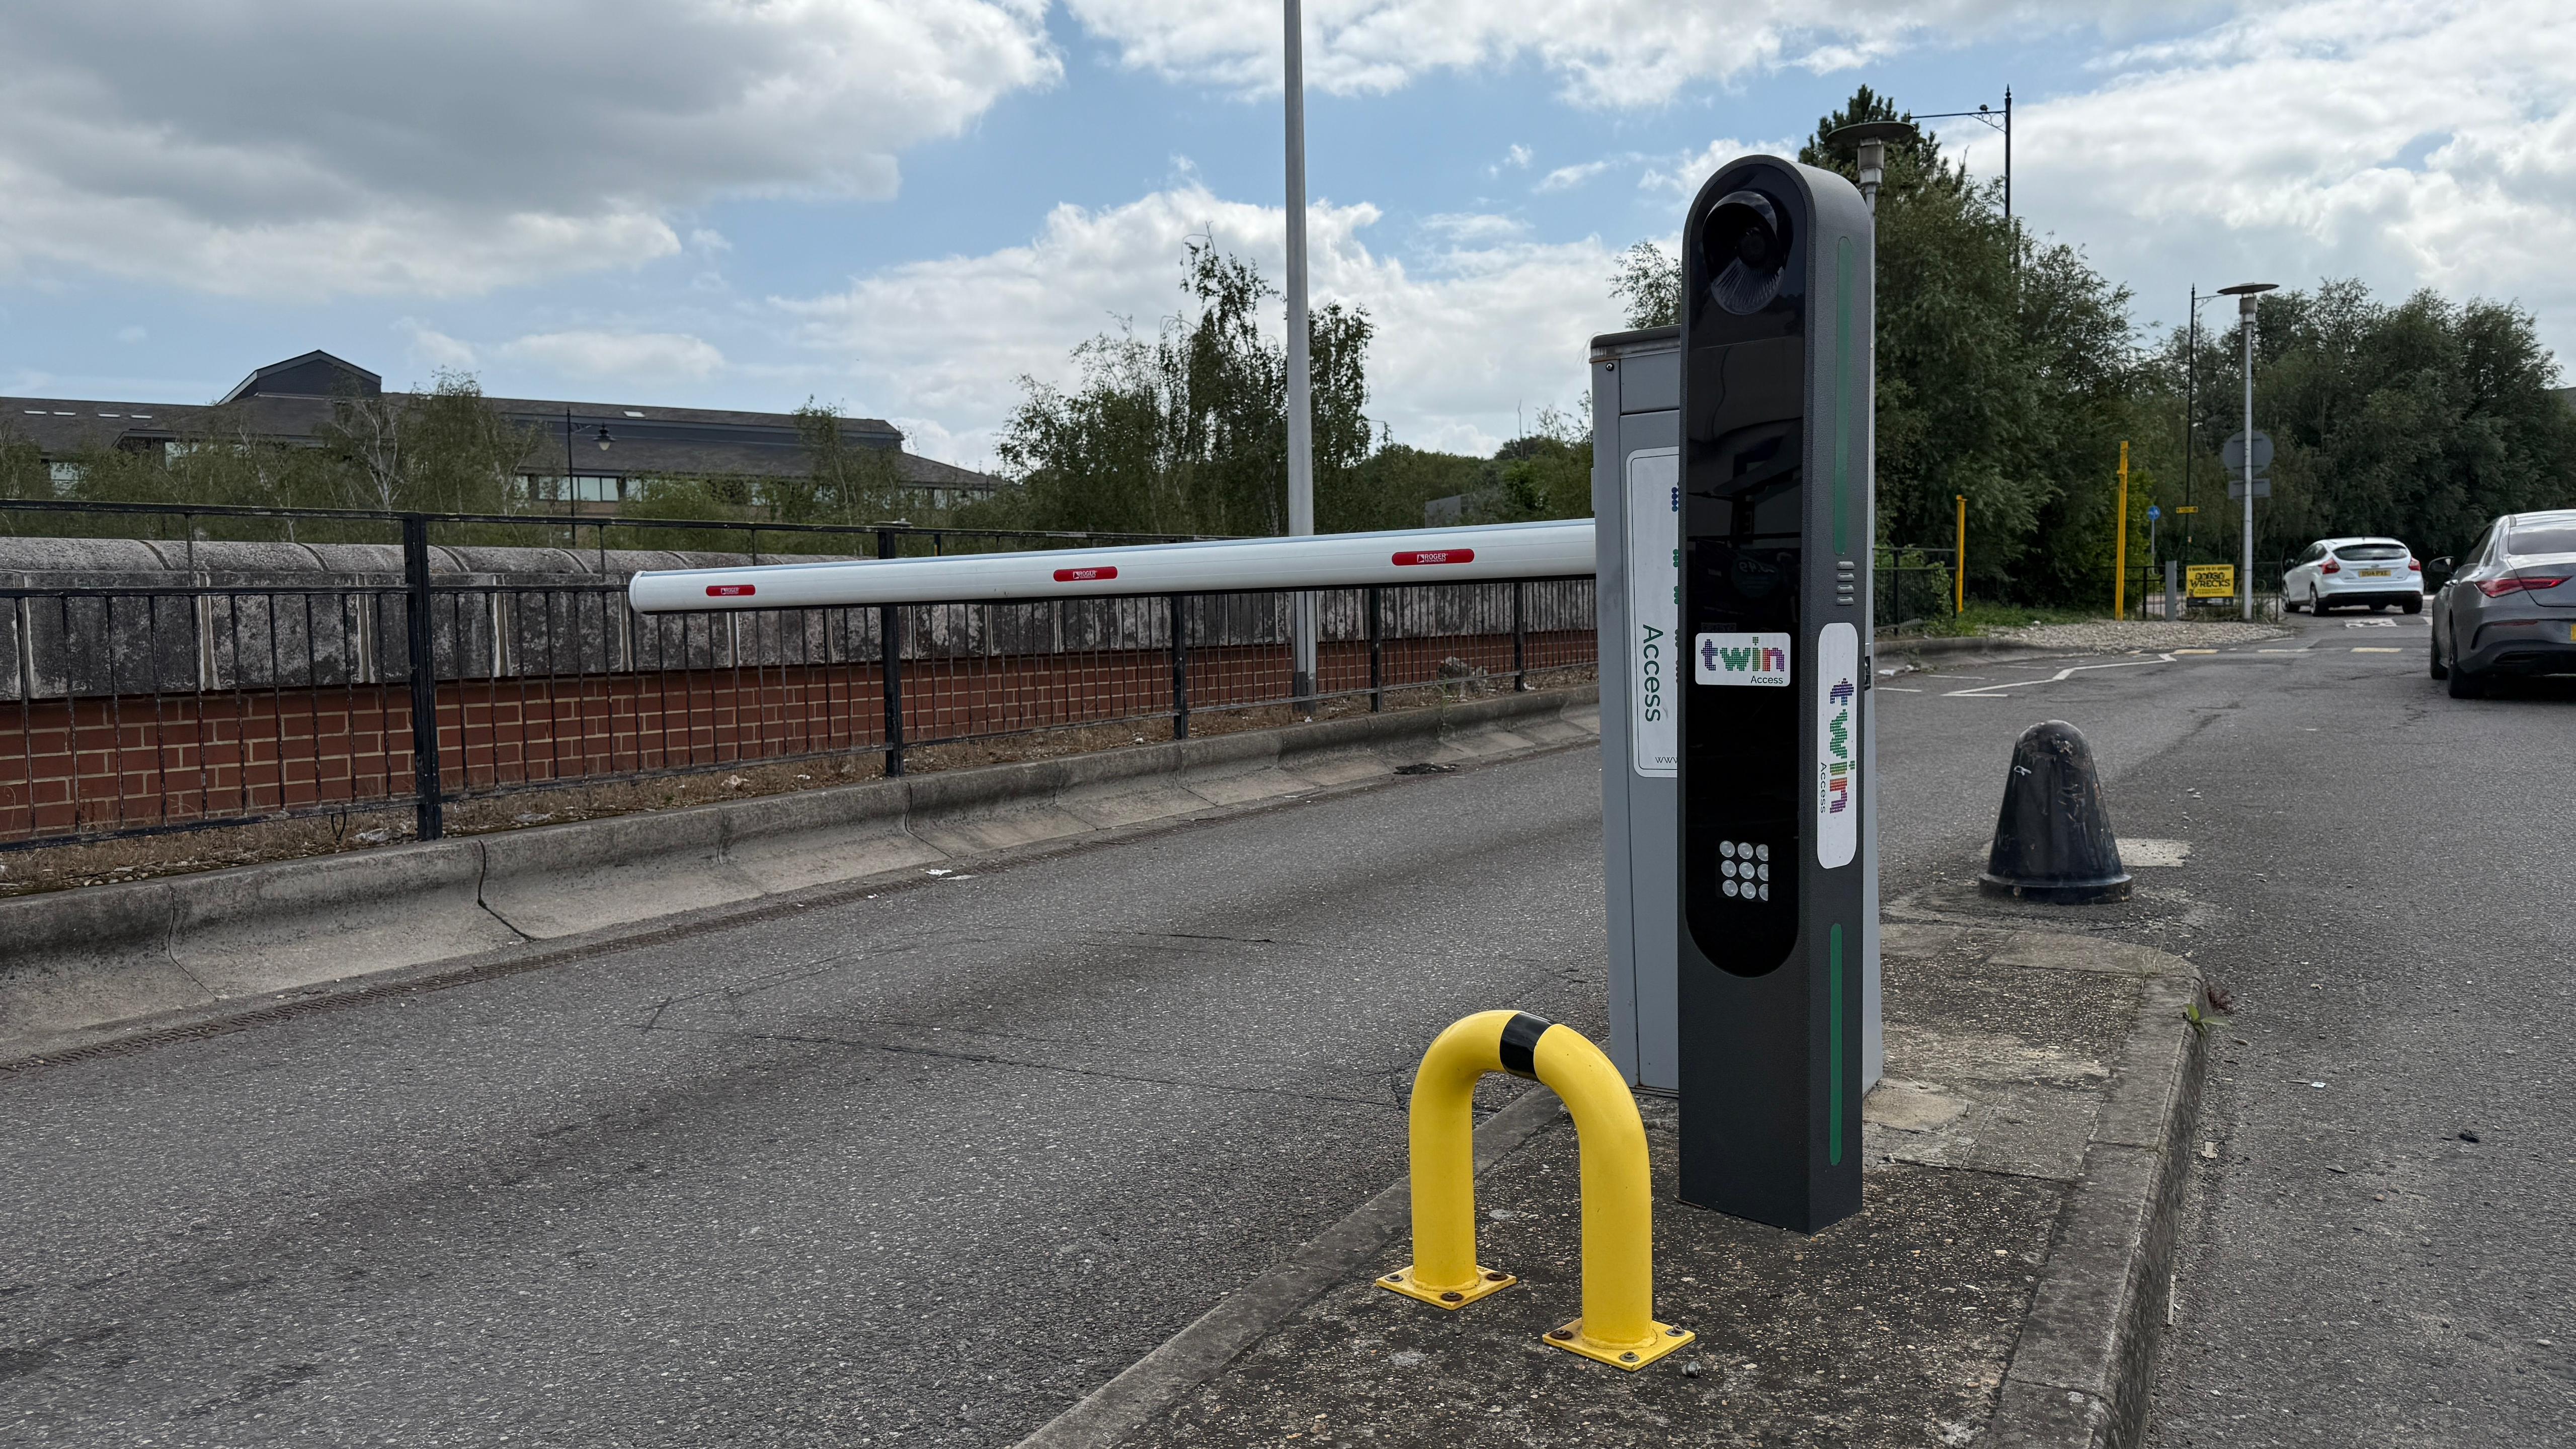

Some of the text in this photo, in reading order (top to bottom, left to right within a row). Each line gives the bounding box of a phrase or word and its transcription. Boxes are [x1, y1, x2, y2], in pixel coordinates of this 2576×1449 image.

[2190, 579, 2230, 587] WRECKS
[1701, 636, 1785, 672] twin
[1643, 624, 1663, 722] Access
[1750, 676, 1784, 684] Access
[1829, 678, 1855, 814] twin
